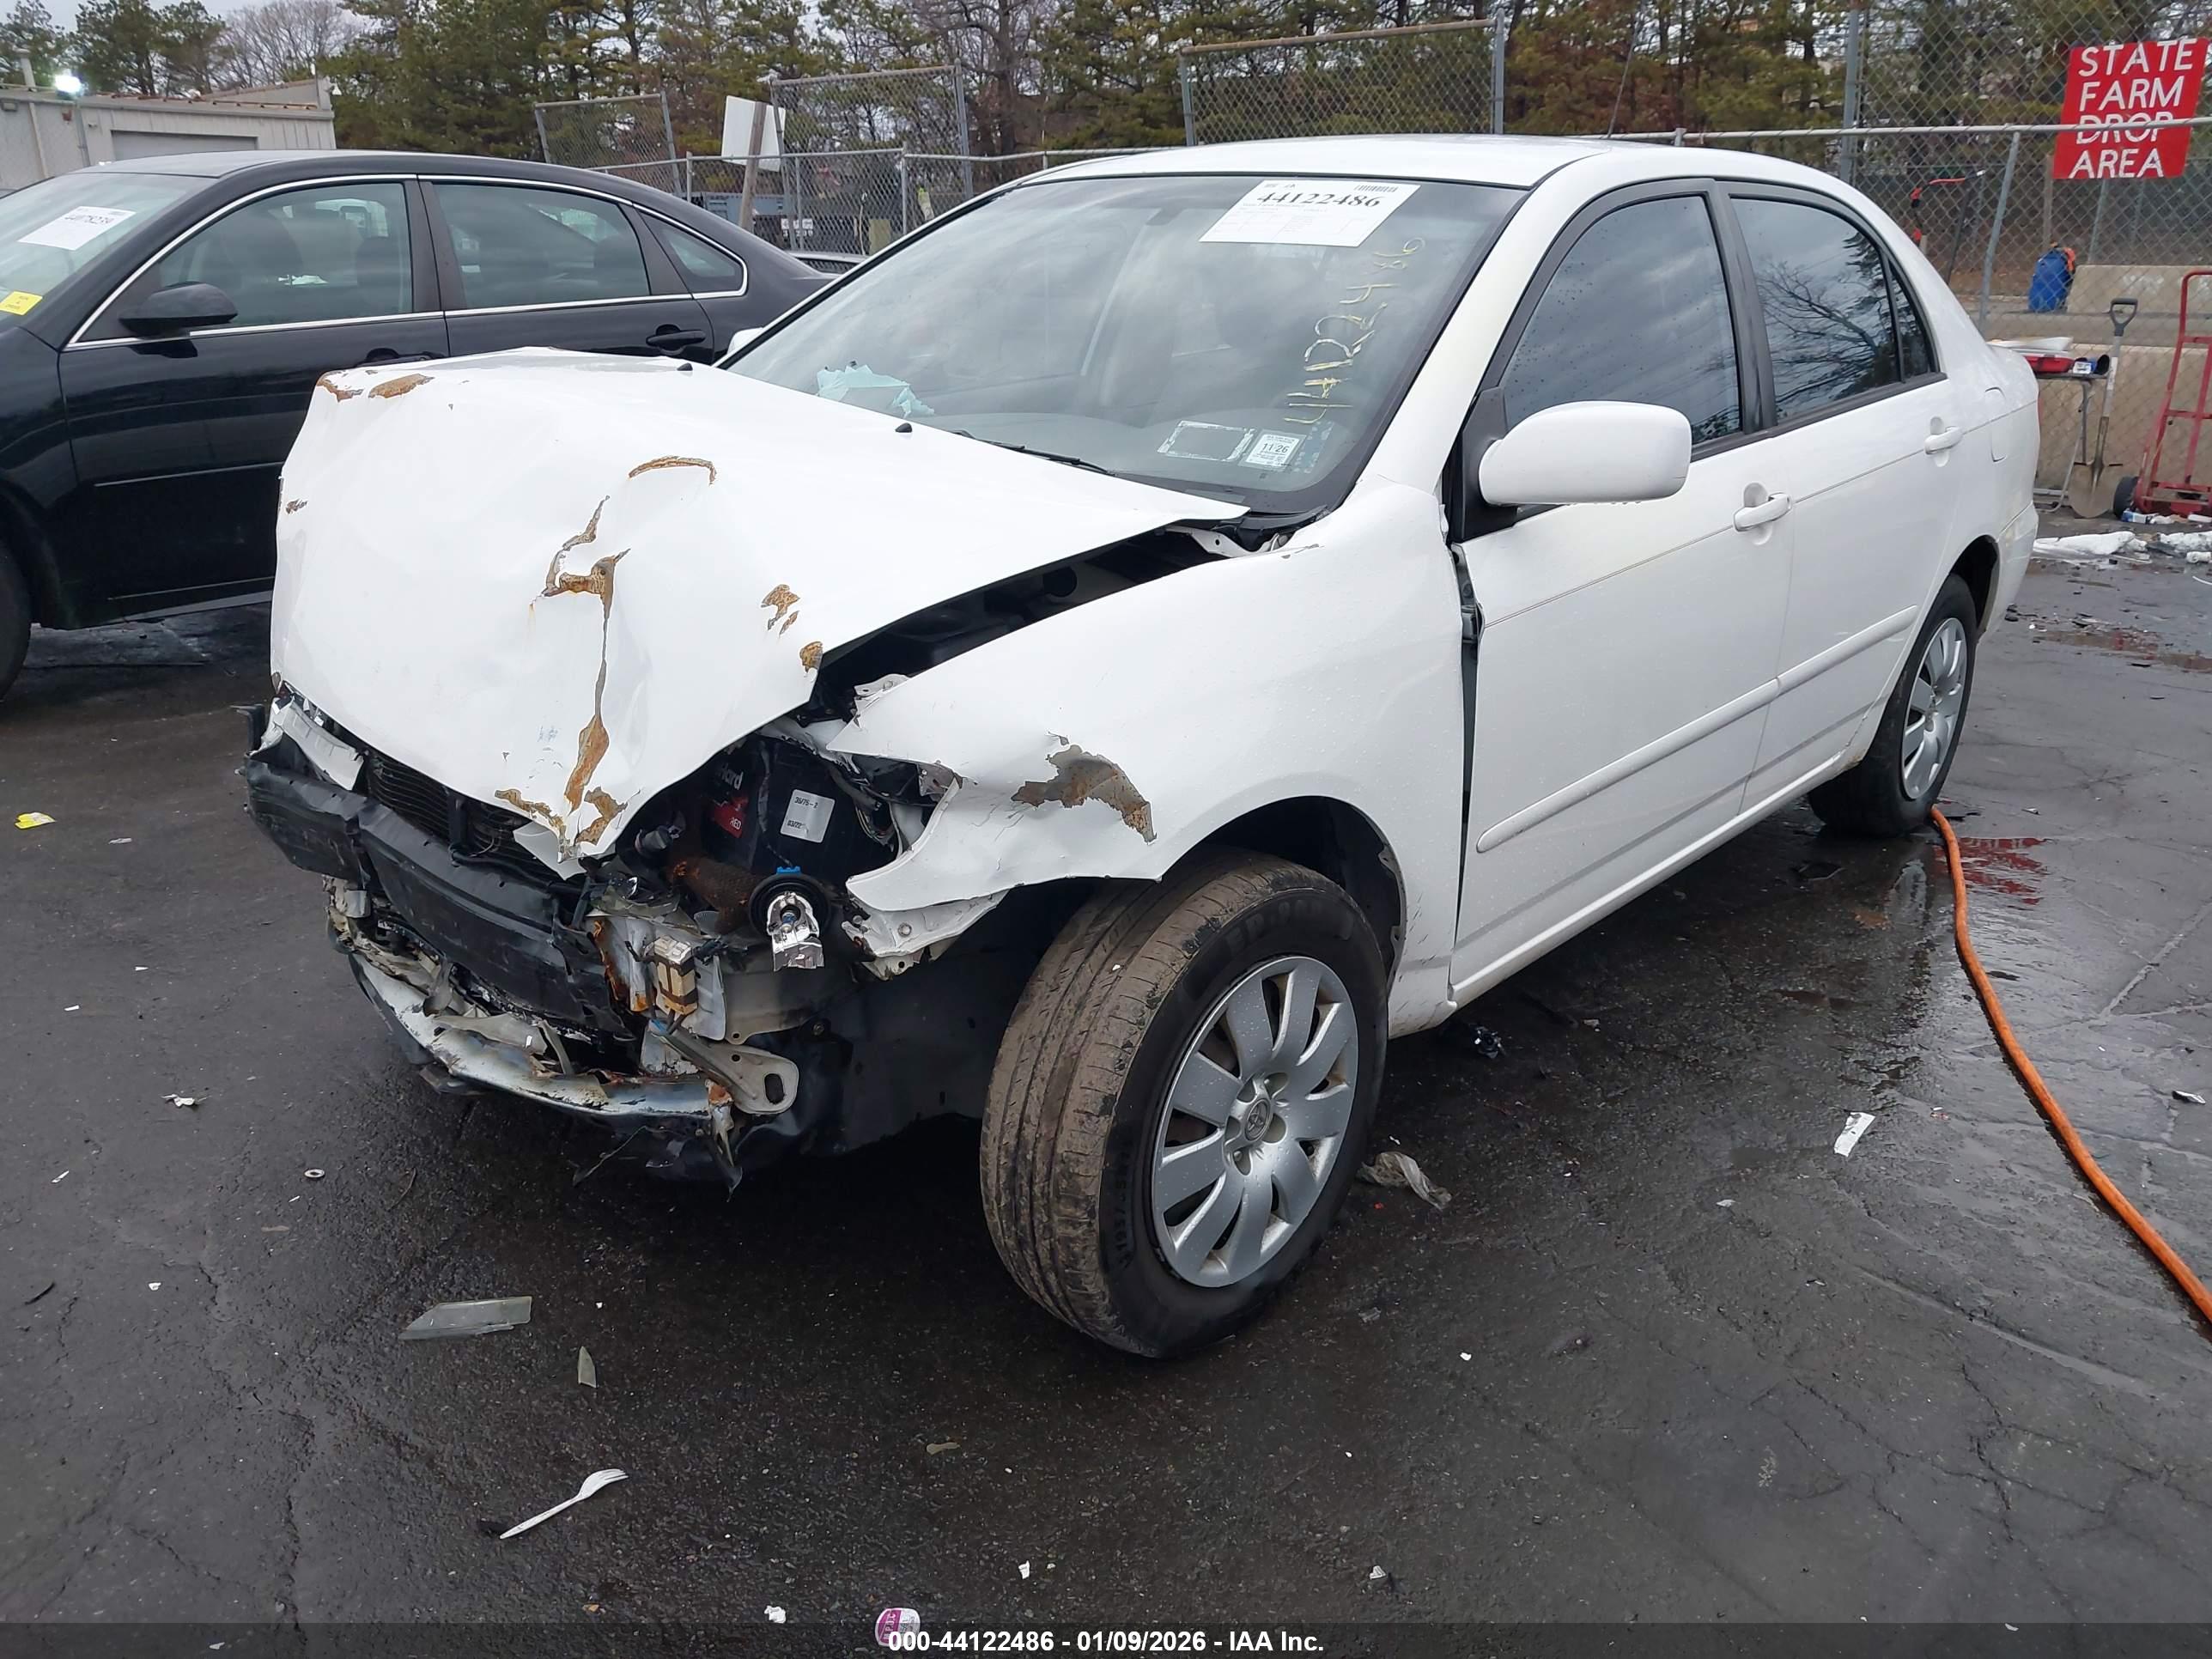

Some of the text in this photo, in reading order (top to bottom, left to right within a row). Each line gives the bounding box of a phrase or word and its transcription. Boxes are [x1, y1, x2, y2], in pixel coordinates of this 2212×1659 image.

[2078, 38, 2197, 76] STATE
[2079, 76, 2185, 112] FARM
[2076, 112, 2173, 144] DROP
[2068, 149, 2164, 179] AREA
[1257, 192, 1386, 208] 44122486
